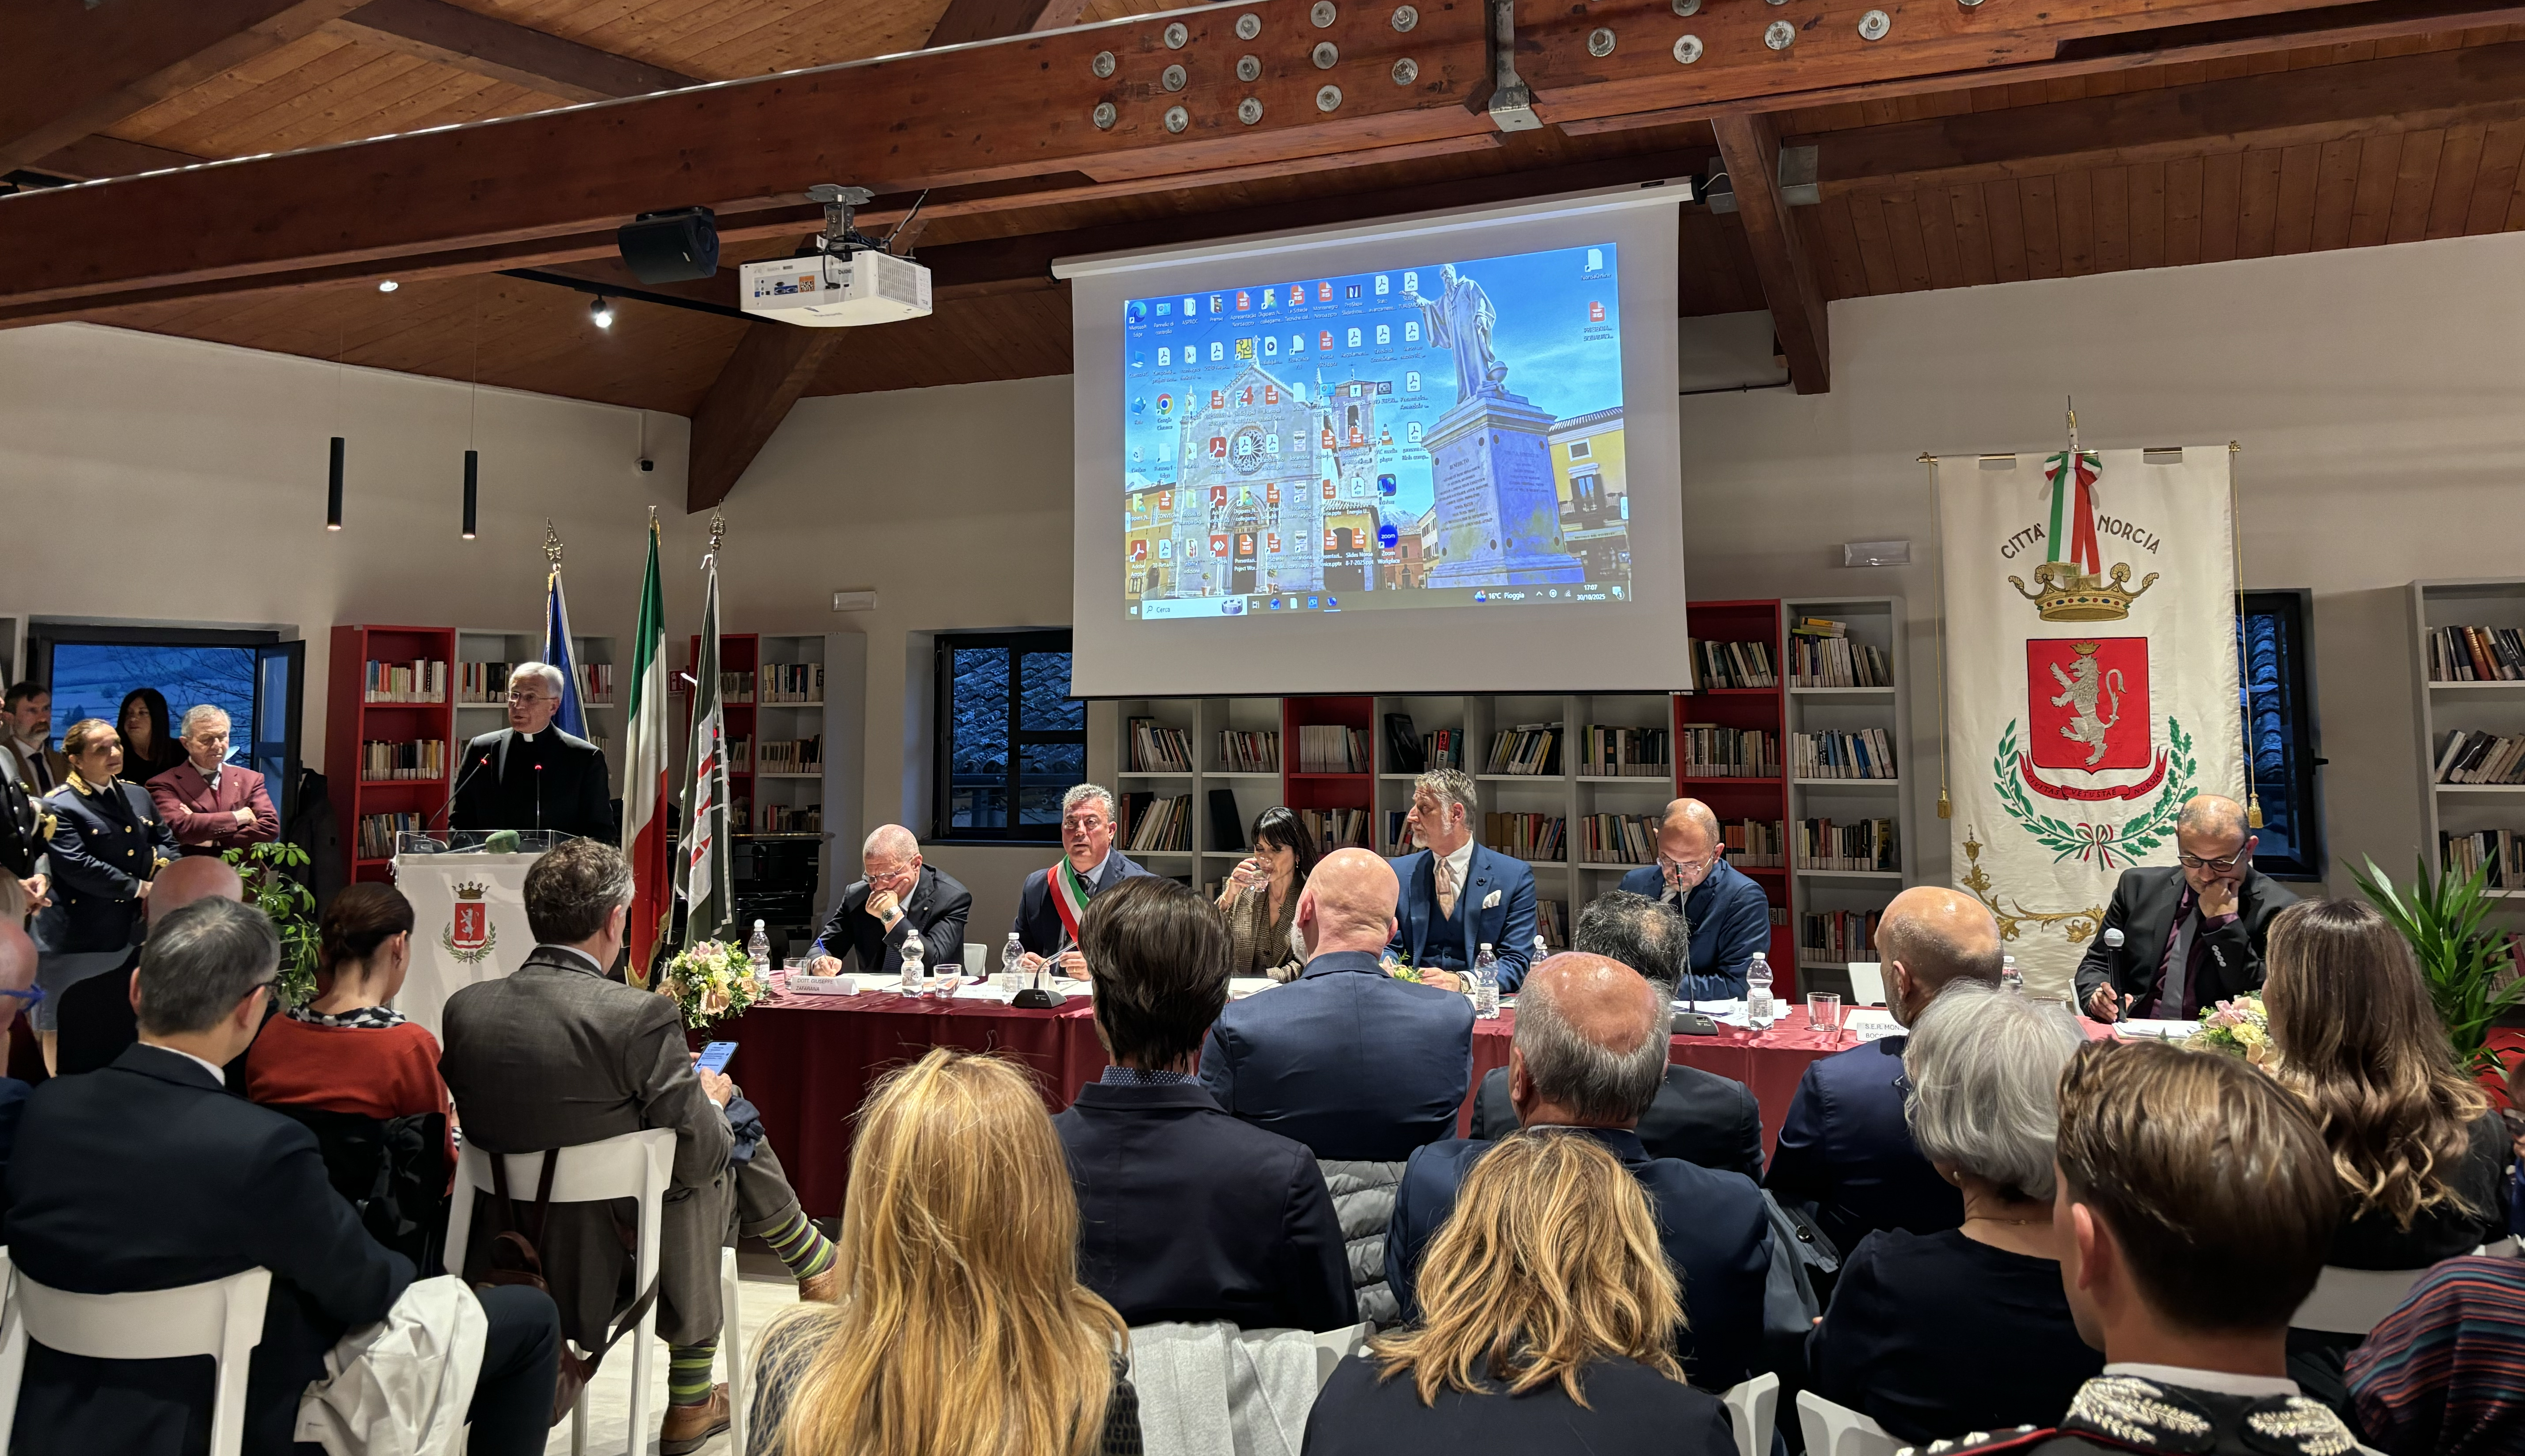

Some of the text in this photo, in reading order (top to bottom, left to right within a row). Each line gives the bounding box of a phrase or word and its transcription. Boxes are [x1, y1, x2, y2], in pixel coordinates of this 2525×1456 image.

[2097, 515, 2160, 554] NORCIA
[1504, 592, 1525, 600] Pioggia
[2028, 770, 2163, 797] CIVITAS VETUSTAE NURSIAE
